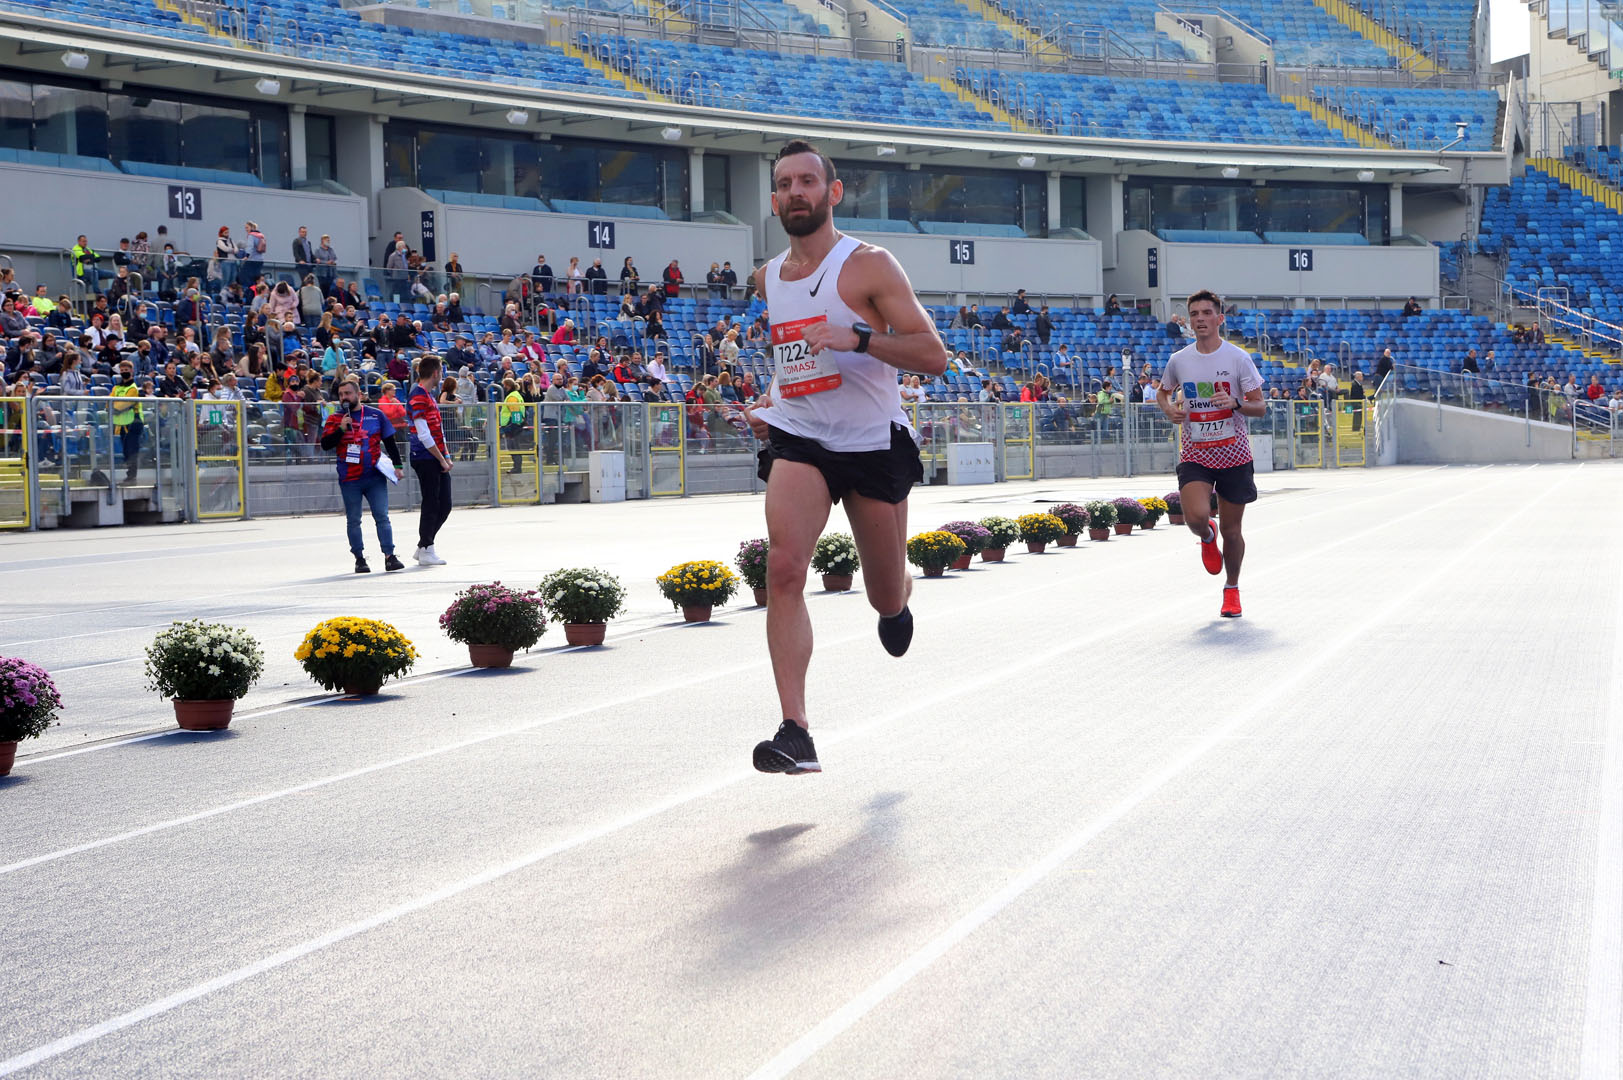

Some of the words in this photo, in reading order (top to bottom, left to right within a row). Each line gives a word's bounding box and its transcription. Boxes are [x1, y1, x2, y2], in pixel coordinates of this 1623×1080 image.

[175, 191, 195, 214] 13
[593, 225, 610, 245] 14
[954, 243, 970, 260] 15
[1293, 252, 1308, 268] 16
[783, 360, 816, 375] TOMASZ
[212, 412, 220, 423] 18
[513, 412, 521, 422] 19
[1199, 420, 1224, 432] 7717
